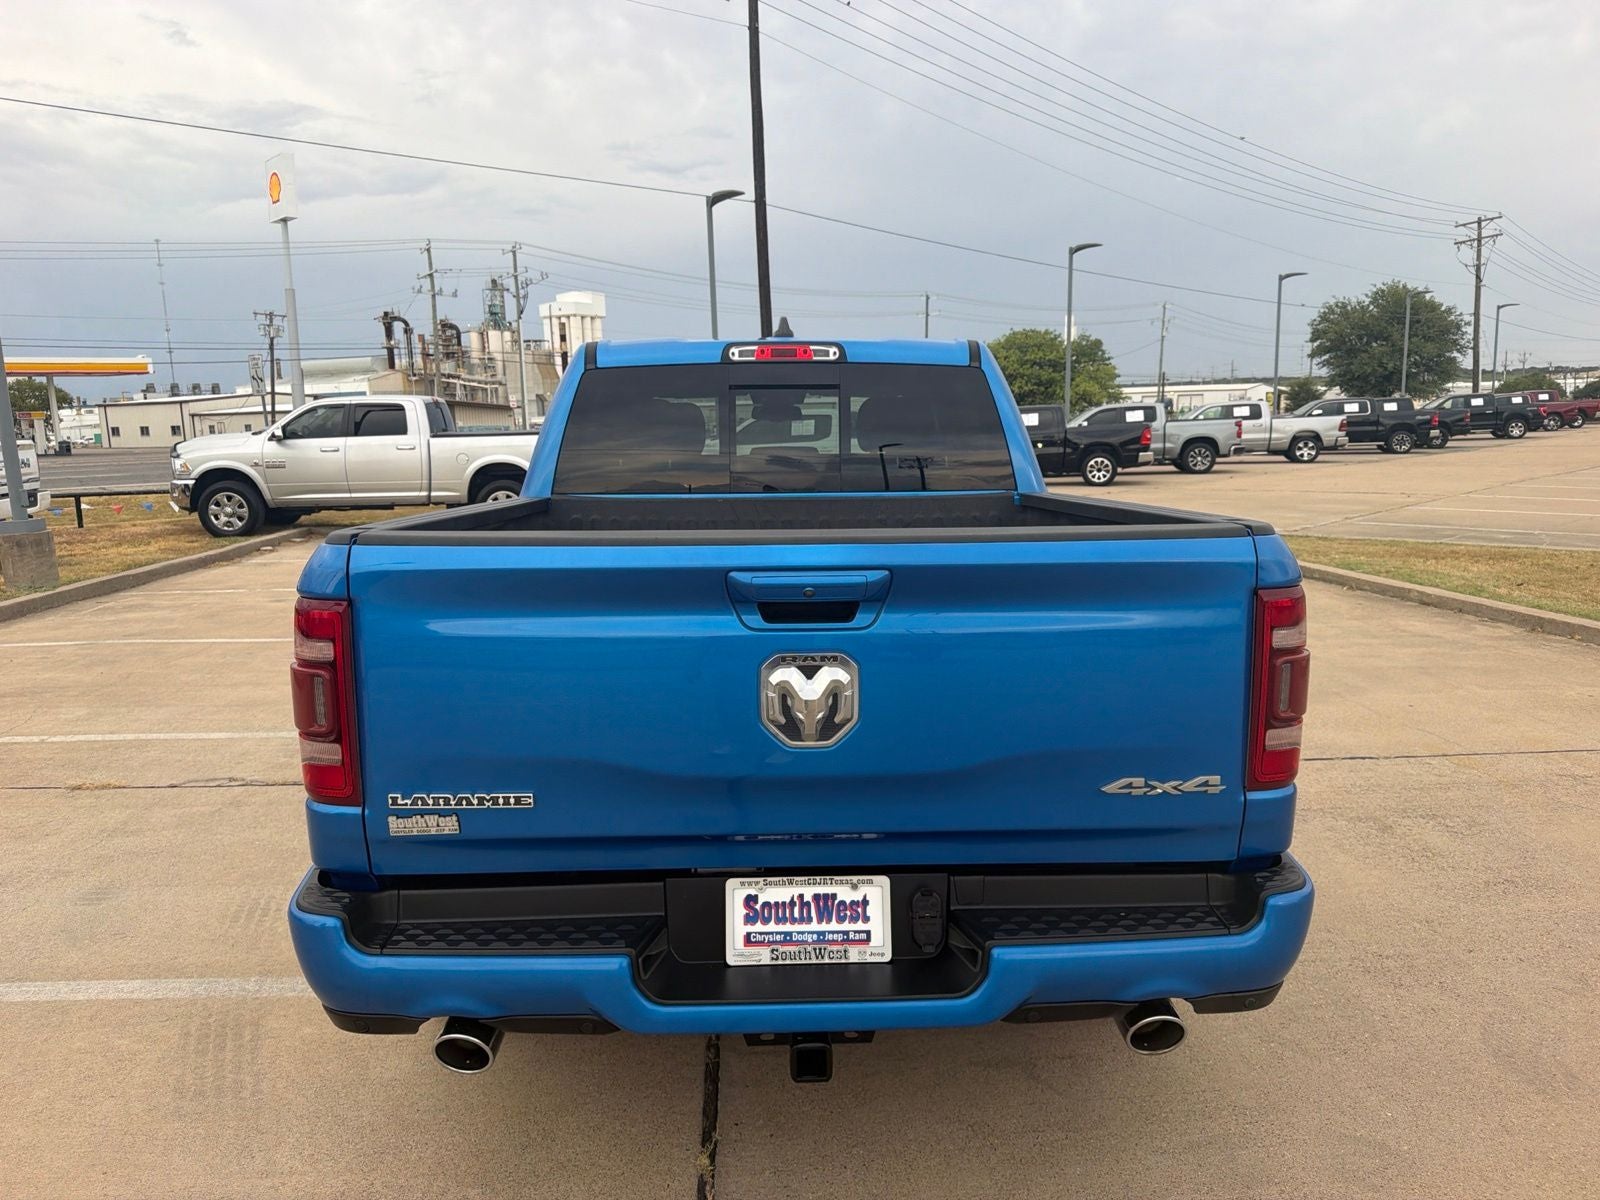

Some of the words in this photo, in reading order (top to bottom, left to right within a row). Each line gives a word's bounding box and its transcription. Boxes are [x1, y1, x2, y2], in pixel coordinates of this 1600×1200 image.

[780, 655, 839, 663] RAM
[388, 793, 534, 808] LARAMIE
[388, 813, 459, 828] SouthWest
[739, 878, 874, 887] wwwSouthWestCDJRTexascom
[743, 893, 871, 926] SouthWest
[750, 932, 784, 943] Chrysler
[792, 932, 818, 942] Dodge
[825, 931, 843, 941] Jeep
[849, 931, 867, 940] Ram
[770, 947, 850, 962] SouthWest
